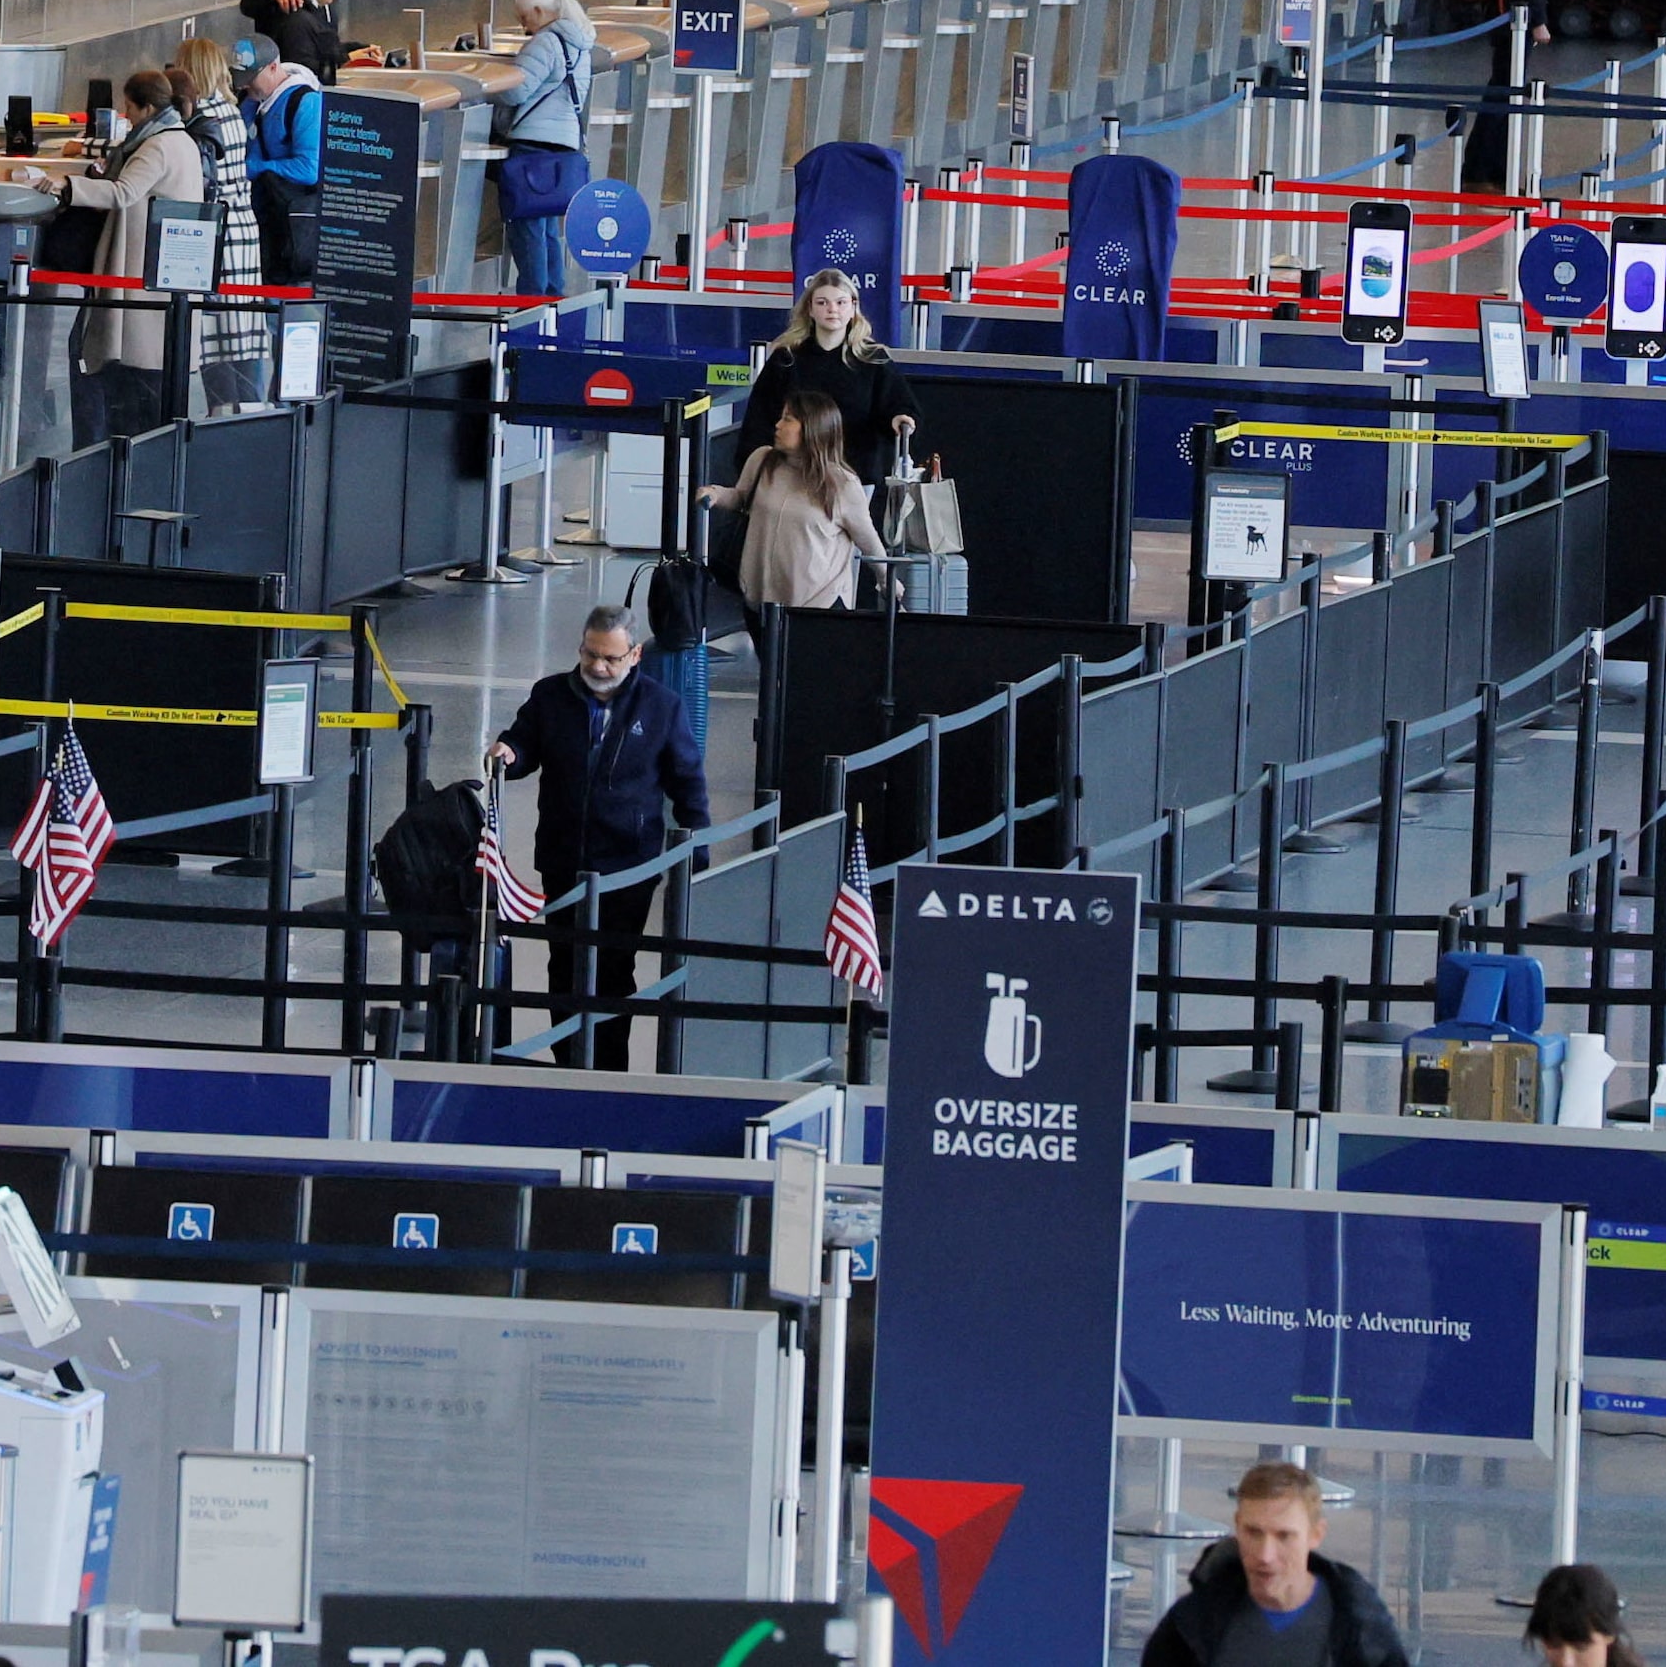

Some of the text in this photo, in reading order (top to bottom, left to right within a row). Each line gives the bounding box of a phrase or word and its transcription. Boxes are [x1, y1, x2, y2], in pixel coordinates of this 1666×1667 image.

[682, 11, 733, 32] EXIT
[1074, 285, 1146, 305] CLEAR
[1545, 294, 1565, 302] Enroll
[1230, 440, 1313, 461] CLEAR
[1286, 462, 1312, 472] PLUS
[958, 893, 1076, 922] DELTA
[934, 1097, 1078, 1130] OVERSIZE
[932, 1130, 1077, 1162] BAGGAGE
[1616, 1228, 1649, 1237] CLEAR
[1180, 1301, 1471, 1342] Less Waiting, More Adventuring
[1613, 1399, 1646, 1409] CLEAR
[189, 1495, 269, 1510] DO YOU HAVE
